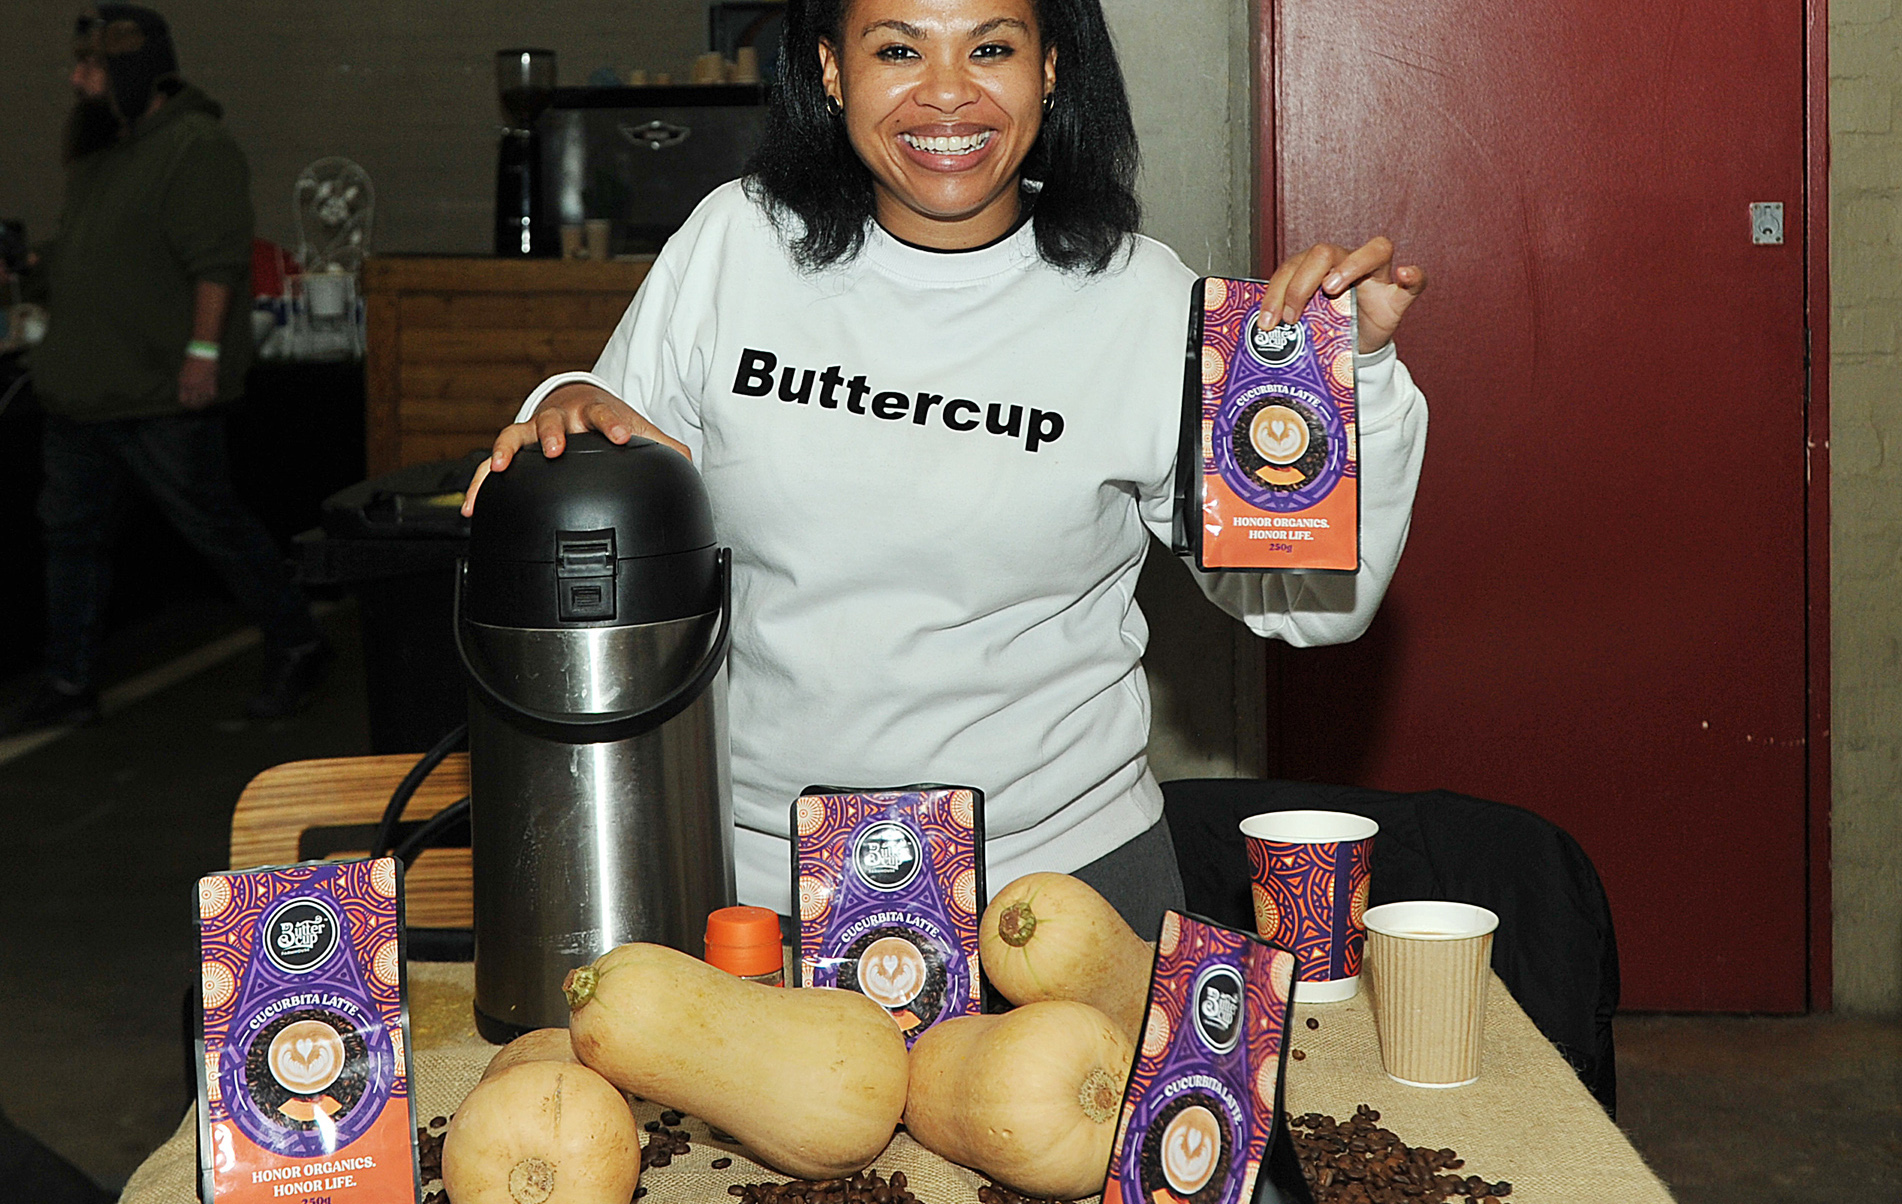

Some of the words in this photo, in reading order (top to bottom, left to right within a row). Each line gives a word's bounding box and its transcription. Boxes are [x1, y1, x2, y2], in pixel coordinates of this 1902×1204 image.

[732, 347, 1065, 453] Buttercup
[1235, 384, 1289, 407] CUCURBITA
[1289, 386, 1322, 407] LATTE
[1233, 517, 1272, 527] HONOR
[1273, 517, 1330, 528] ORGANICS.
[1248, 530, 1287, 539] HONOR
[1288, 531, 1314, 541] LIFE.
[1269, 543, 1293, 553] 250g
[277, 915, 325, 948] Butter
[841, 912, 904, 943] CUCURBITA
[905, 914, 940, 938] LATTE
[295, 934, 318, 948] cup
[249, 993, 322, 1031] CUCURBITA
[321, 995, 359, 1017] LATTE
[1164, 1074, 1223, 1097] CUCURBITA
[1220, 1086, 1243, 1126] LATTE
[252, 1166, 302, 1184] HONOR
[303, 1156, 377, 1177] ORGANICS.
[273, 1179, 323, 1197] HONOR
[324, 1175, 357, 1191] LIFE.
